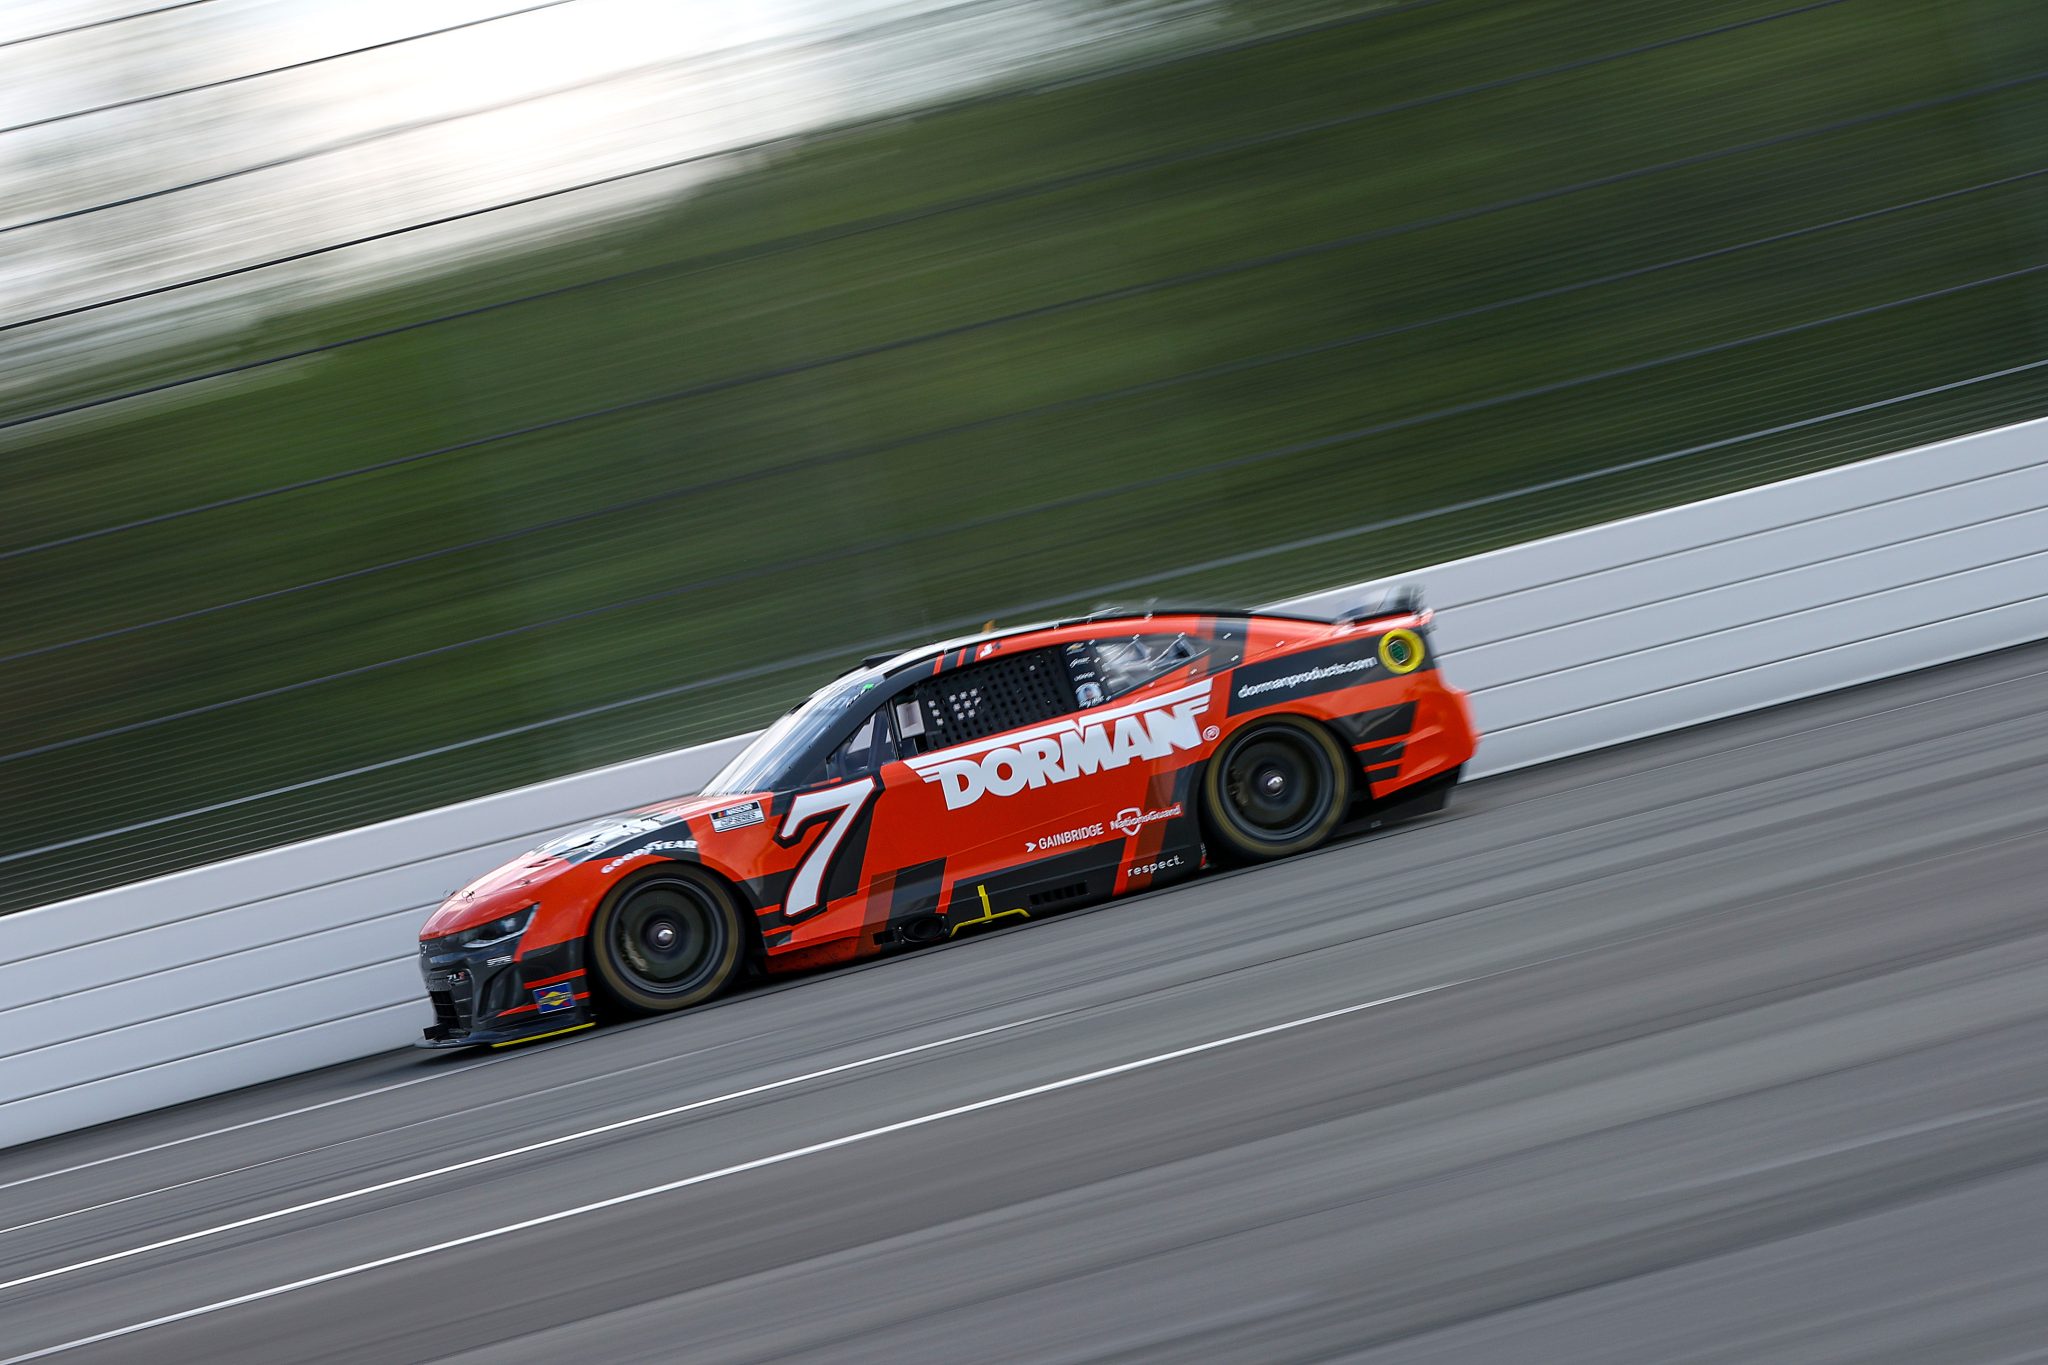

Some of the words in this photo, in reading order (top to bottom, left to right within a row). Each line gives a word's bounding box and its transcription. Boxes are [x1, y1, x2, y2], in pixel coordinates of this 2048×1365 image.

[1238, 656, 1378, 698] dormanproducts.com
[915, 686, 1211, 811] DORMAN
[777, 776, 876, 917] 7
[1038, 822, 1105, 850] GAINBRIDGE
